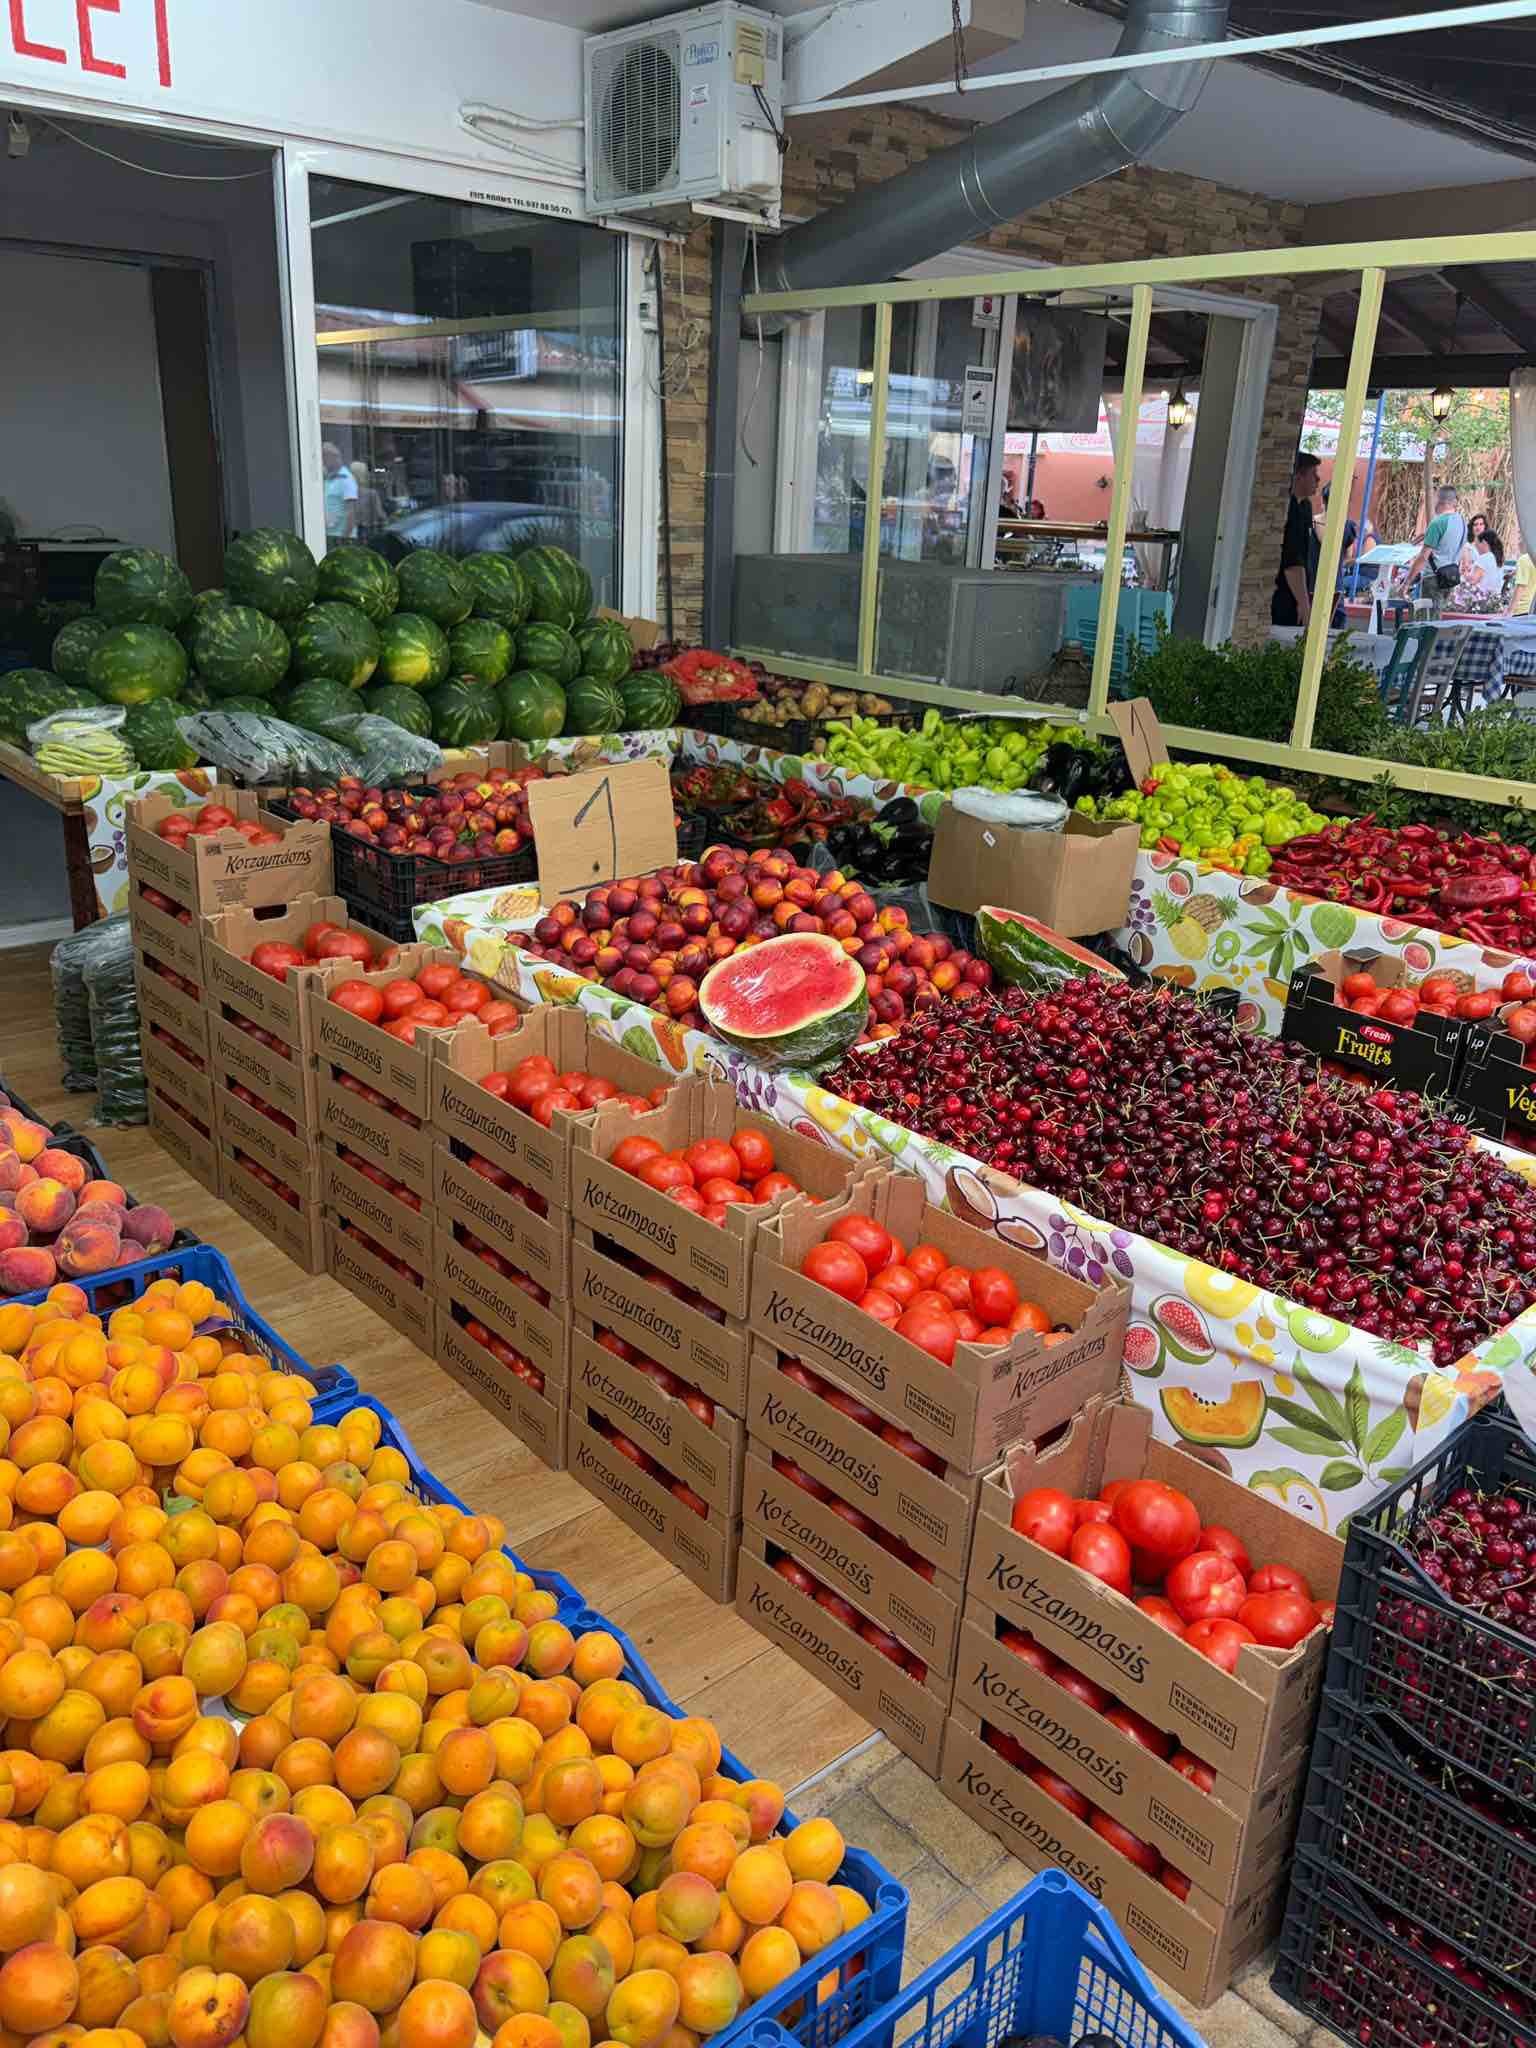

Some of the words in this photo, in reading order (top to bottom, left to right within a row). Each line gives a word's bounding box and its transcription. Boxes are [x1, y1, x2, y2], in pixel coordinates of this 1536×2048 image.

[320, 1018, 383, 1074] Kotzampasis
[1335, 1026, 1392, 1067] Fruits
[1364, 1027, 1393, 1043] Fresh
[583, 1178, 678, 1255] Kotzampasis
[764, 1290, 890, 1391] Kotzampasis
[581, 1359, 673, 1446] Kotzampasis
[761, 1393, 882, 1497] Kotzampasis
[755, 1490, 875, 1595] Kotzampasis
[751, 1584, 864, 1690] Kotzampasis
[987, 1553, 1151, 1684] Kotzampasis
[972, 1662, 1128, 1796] Kotzampasis
[958, 1760, 1109, 1900] Kotzampasis
